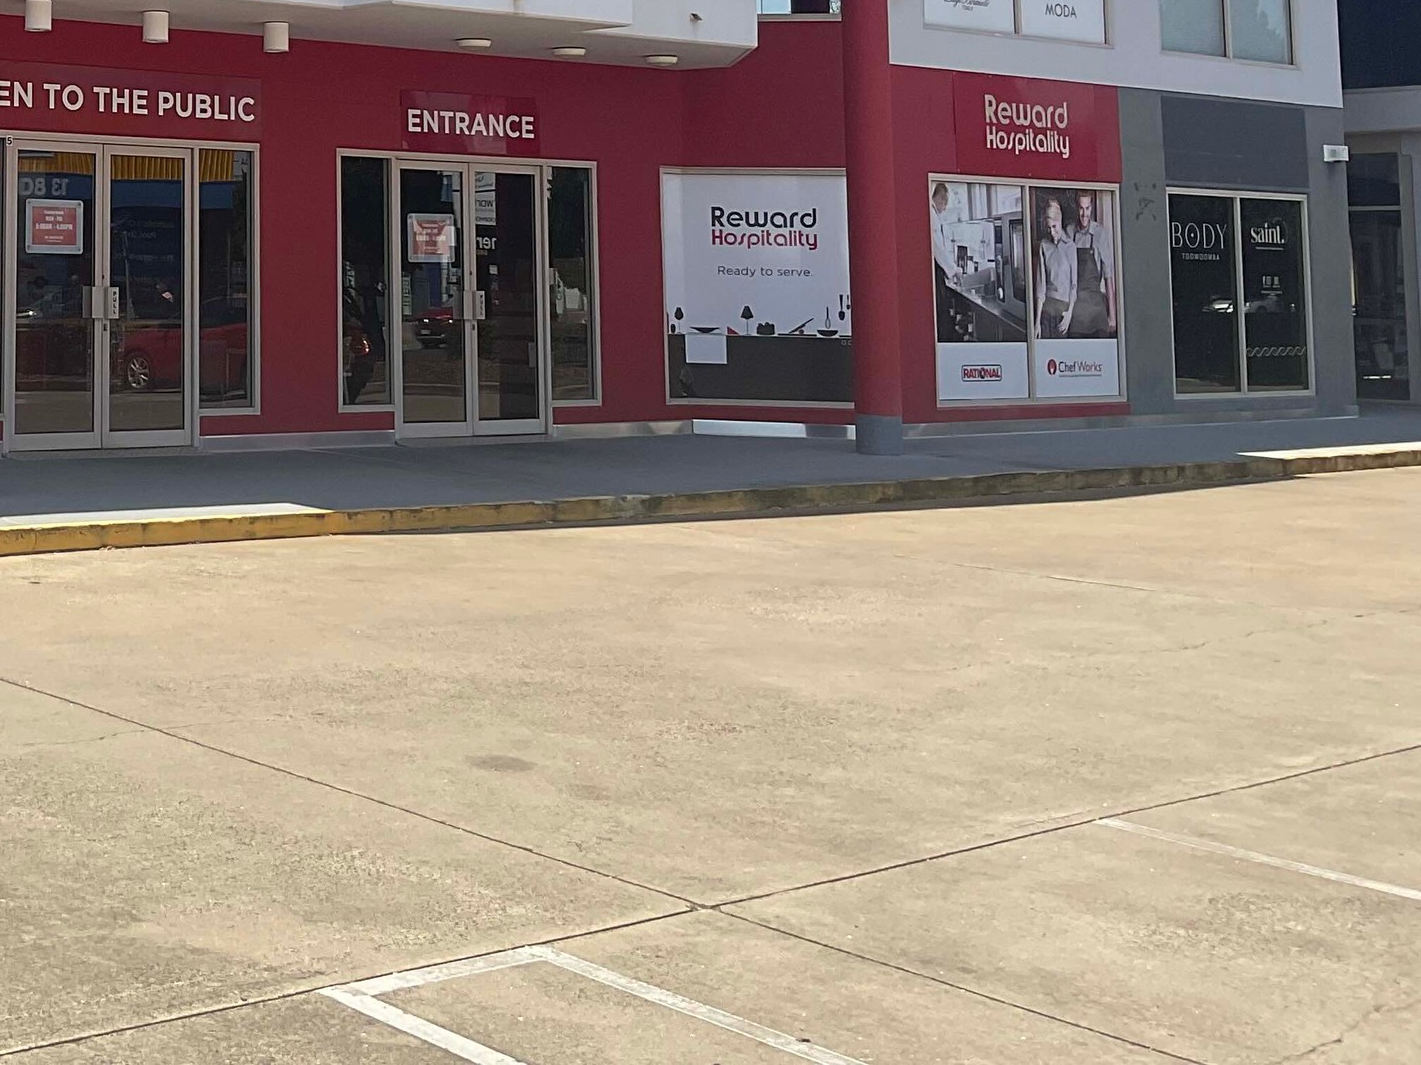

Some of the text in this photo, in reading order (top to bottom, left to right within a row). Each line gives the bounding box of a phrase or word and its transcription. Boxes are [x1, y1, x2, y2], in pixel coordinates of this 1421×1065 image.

[1045, 3, 1077, 18] MODA
[43, 83, 84, 111] TO
[93, 86, 148, 115] THE
[158, 91, 255, 122] PUBLIC
[984, 94, 1068, 128] Reward
[407, 108, 535, 139] ENTRANCE
[6, 136, 13, 146] 5
[986, 125, 1070, 159] Hospitality
[711, 206, 817, 228] Reward
[711, 228, 818, 251] Hospitality
[1172, 222, 1227, 249] BODY
[1182, 253, 1220, 261] TOOWOOMBA
[717, 265, 756, 278] Ready
[760, 267, 773, 277] to
[963, 368, 1001, 378] RATIONAL
[1059, 360, 1102, 373] Chef Works
